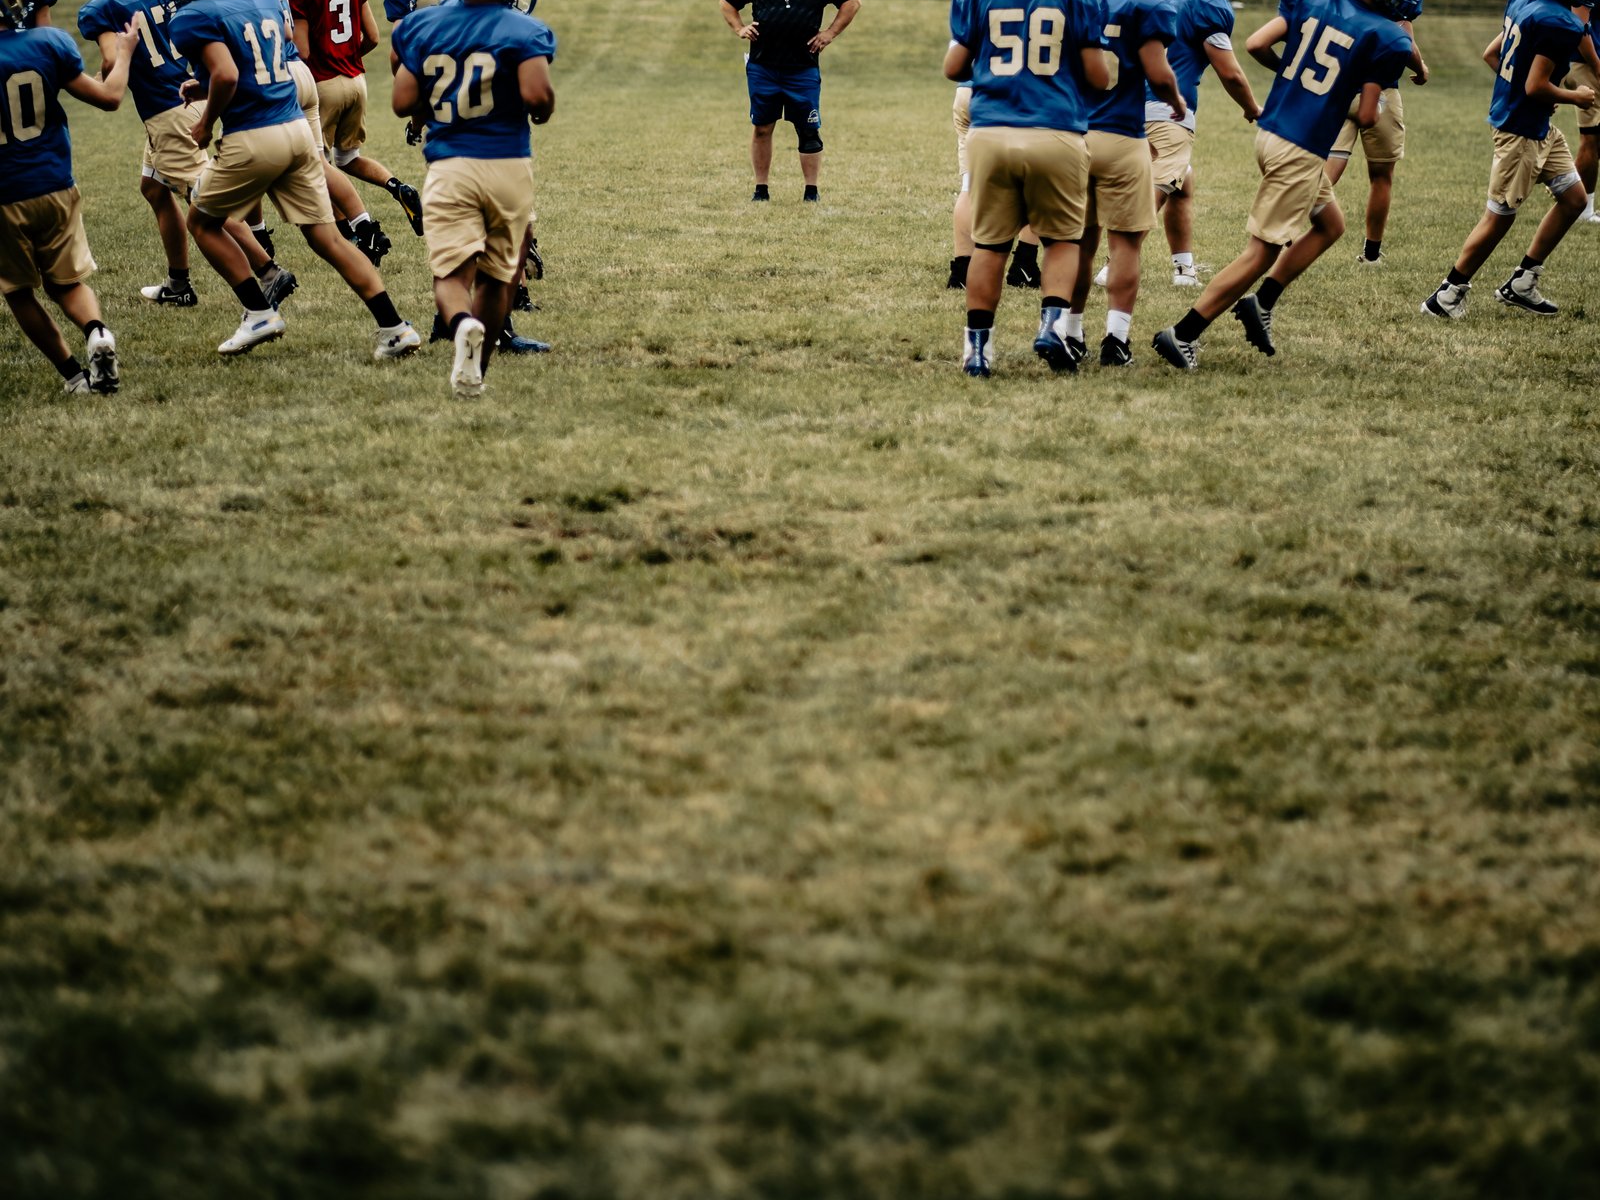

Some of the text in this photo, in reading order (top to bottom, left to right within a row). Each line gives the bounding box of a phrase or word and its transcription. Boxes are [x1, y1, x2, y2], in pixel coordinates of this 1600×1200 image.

[243, 19, 292, 85] 12
[988, 7, 1066, 76] 58
[1282, 17, 1355, 96] 15
[0, 70, 46, 145] 0
[422, 52, 496, 124] 20
